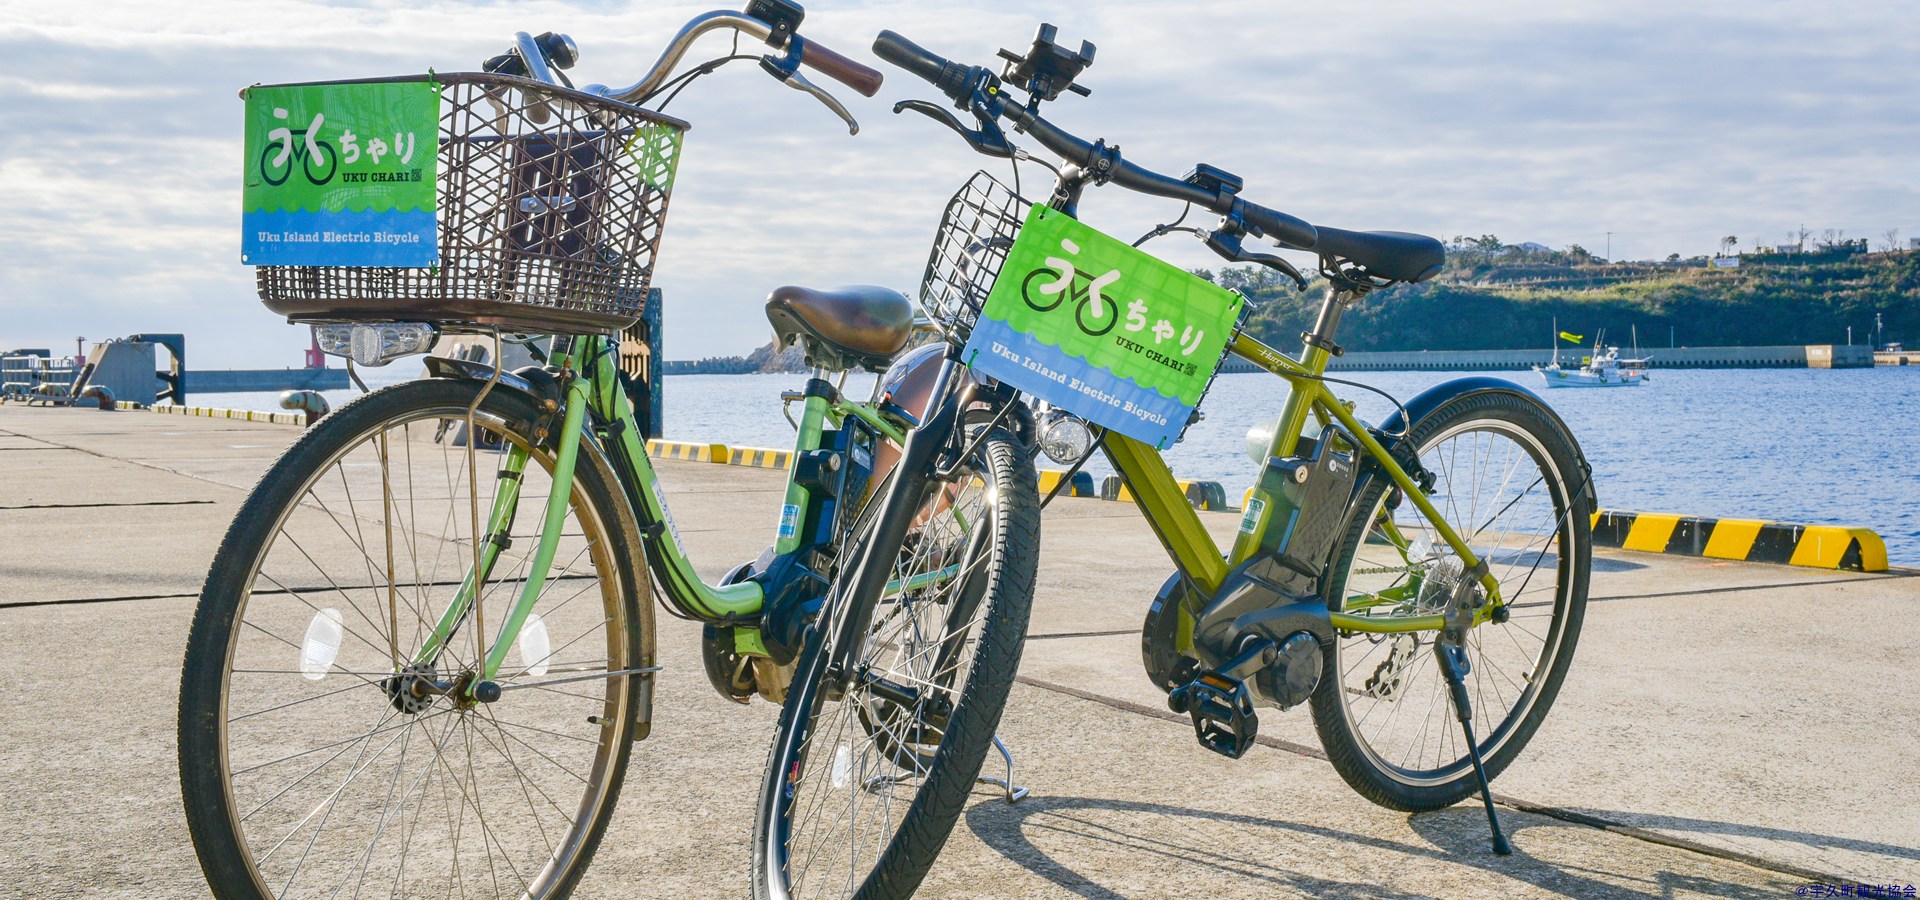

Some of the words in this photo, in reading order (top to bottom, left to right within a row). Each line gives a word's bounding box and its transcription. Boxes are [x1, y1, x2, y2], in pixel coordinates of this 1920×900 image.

[342, 173, 367, 183] UKU
[371, 171, 409, 183] CHARI
[258, 231, 281, 243] Uku
[283, 231, 320, 243] Island
[323, 231, 371, 243] Electric
[373, 231, 420, 244] Bicycle
[1115, 335, 1145, 355] UKU
[1145, 349, 1186, 372] CHARI
[991, 341, 1019, 364] Uku
[1022, 356, 1067, 385] Island
[1068, 377, 1121, 408] Electric
[1122, 401, 1168, 427] Bicycle
